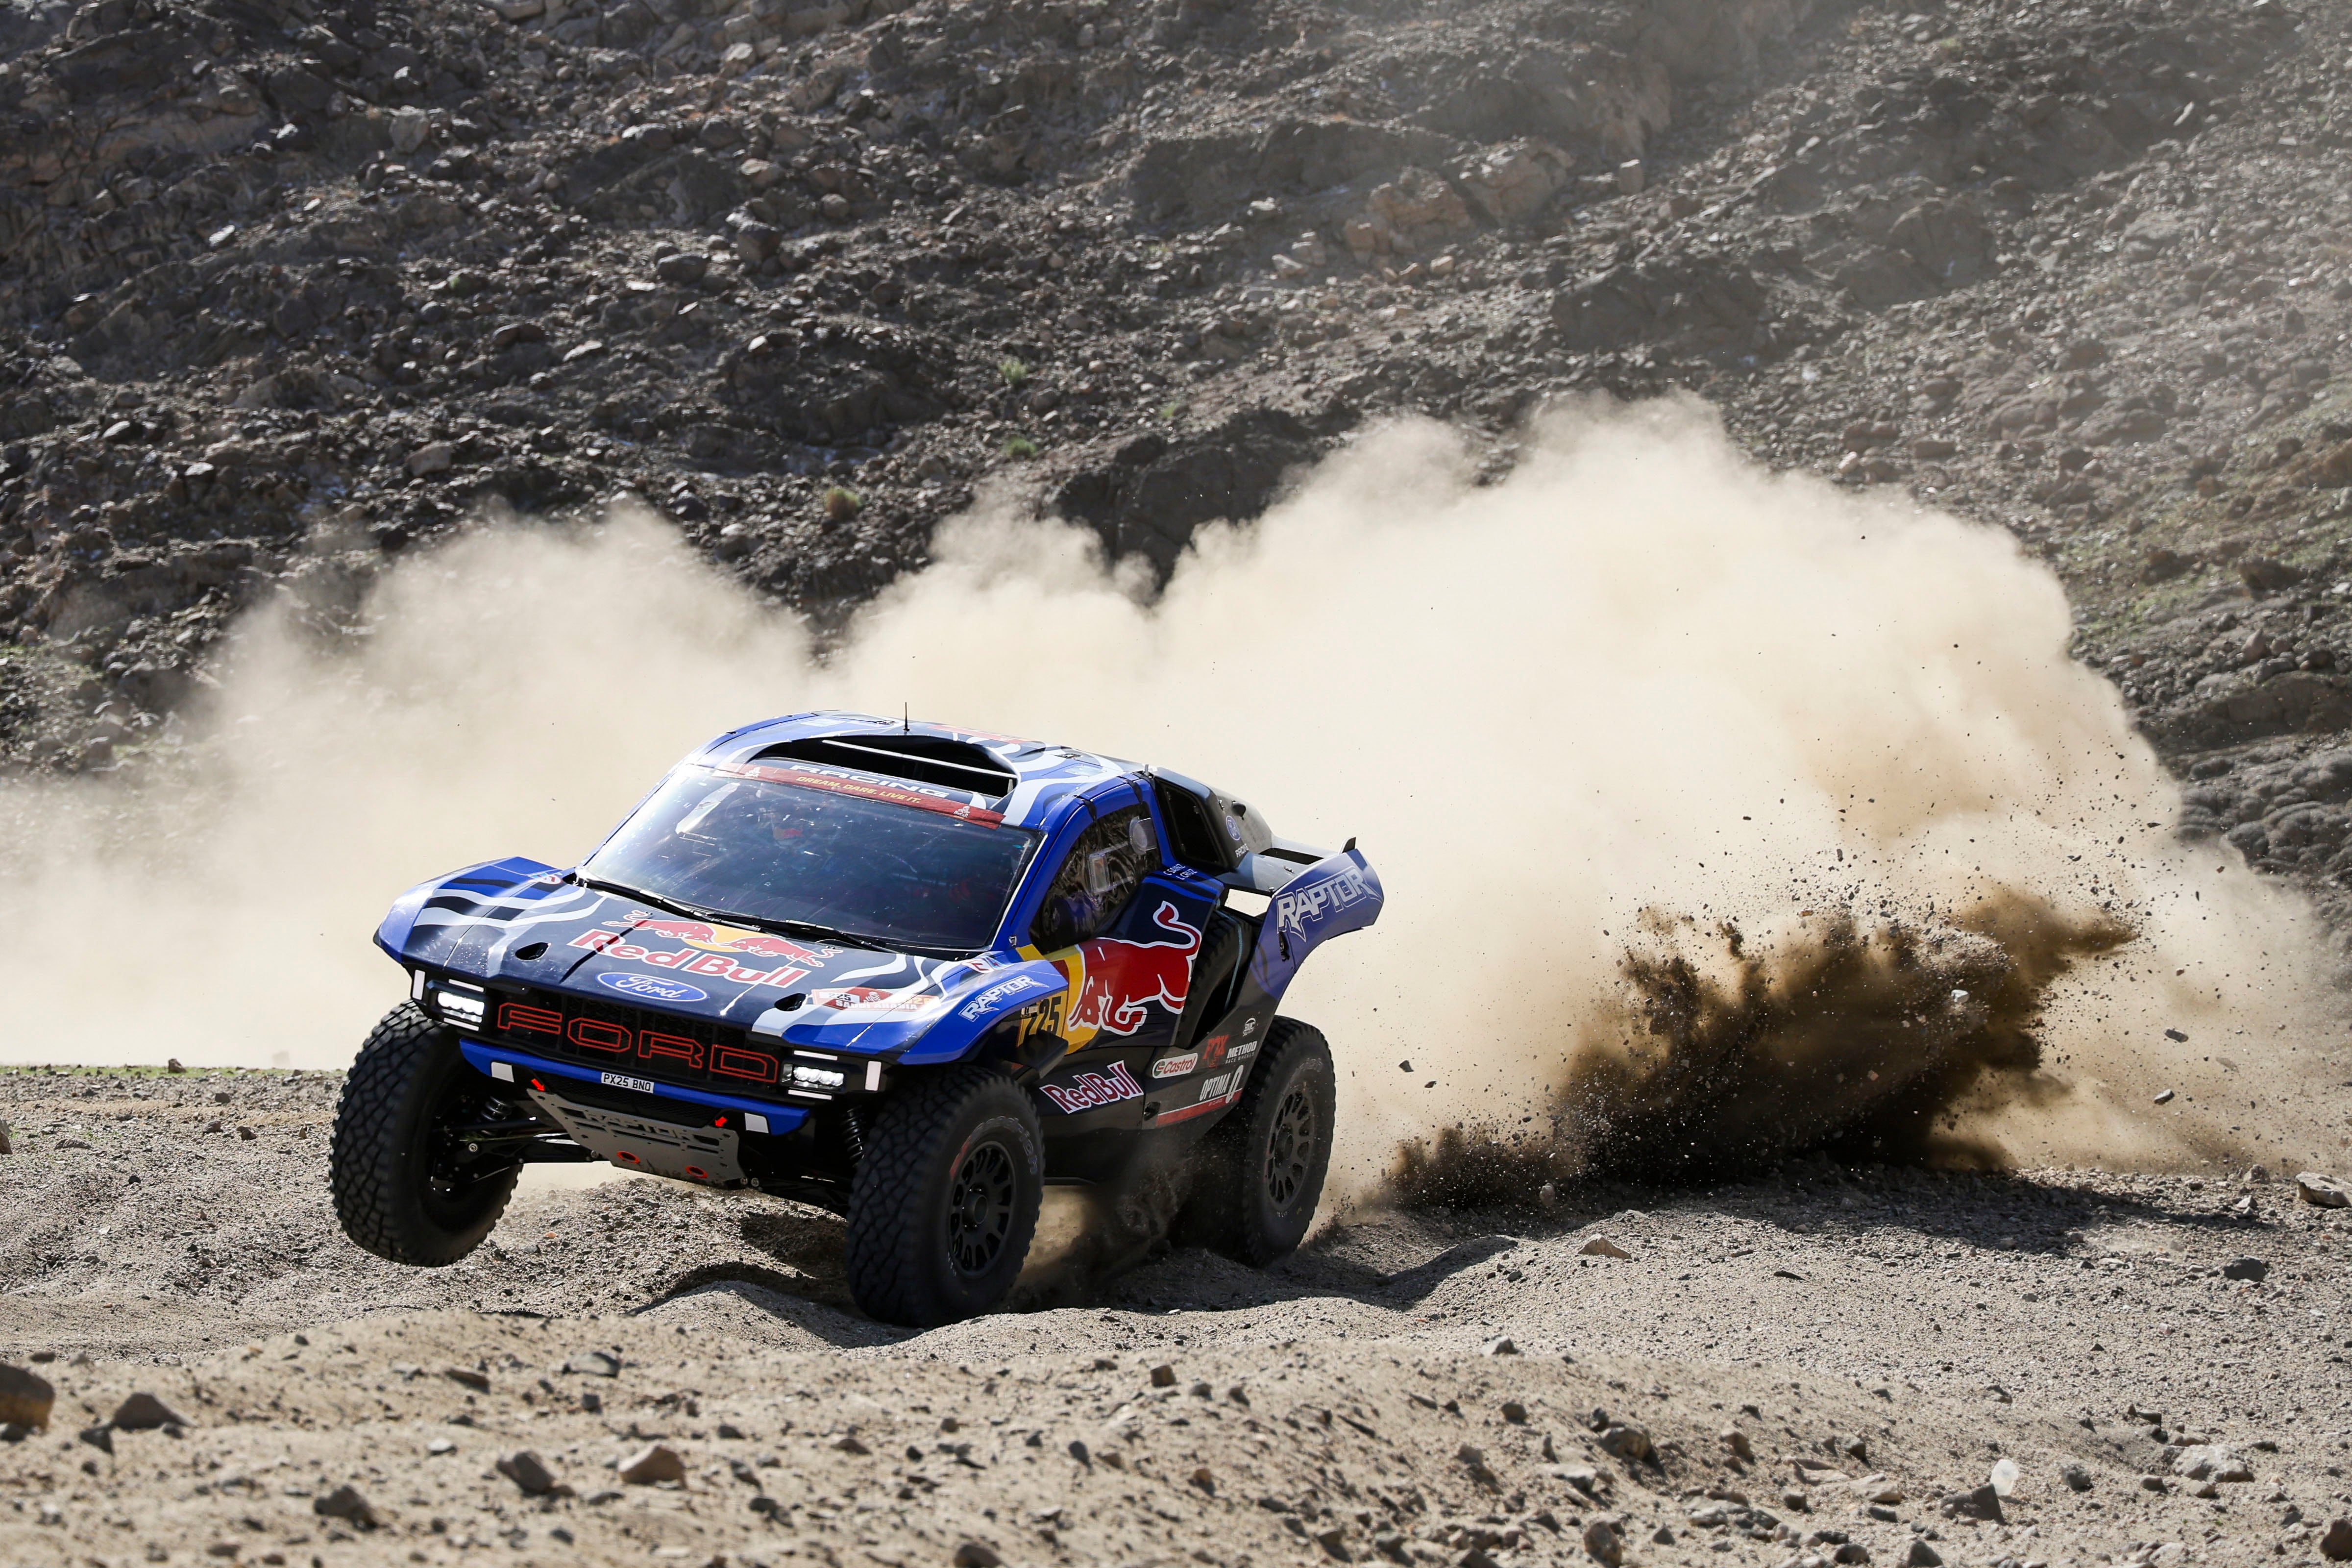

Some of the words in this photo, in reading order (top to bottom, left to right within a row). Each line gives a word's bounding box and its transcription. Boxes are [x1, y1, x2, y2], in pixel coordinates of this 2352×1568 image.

[789, 765, 950, 798] RACING
[796, 776, 841, 787] DREAM.
[842, 783, 877, 794] DARE.
[879, 791, 906, 800] LIVE
[1180, 868, 1198, 878] CRUZ
[1276, 867, 1382, 938] RAPTOR
[567, 929, 695, 969] Red
[681, 947, 811, 988] Bull
[615, 976, 682, 999] Ford
[958, 975, 1050, 1022] RAPTOR
[497, 1002, 779, 1083] FORD
[1226, 1040, 1258, 1059] METHOD
[1163, 1057, 1196, 1074] Castrol
[603, 1074, 629, 1087] PX25
[1039, 1075, 1108, 1114] Red
[1082, 1060, 1144, 1102] Bull
[1199, 1073, 1231, 1101] OPTIMA
